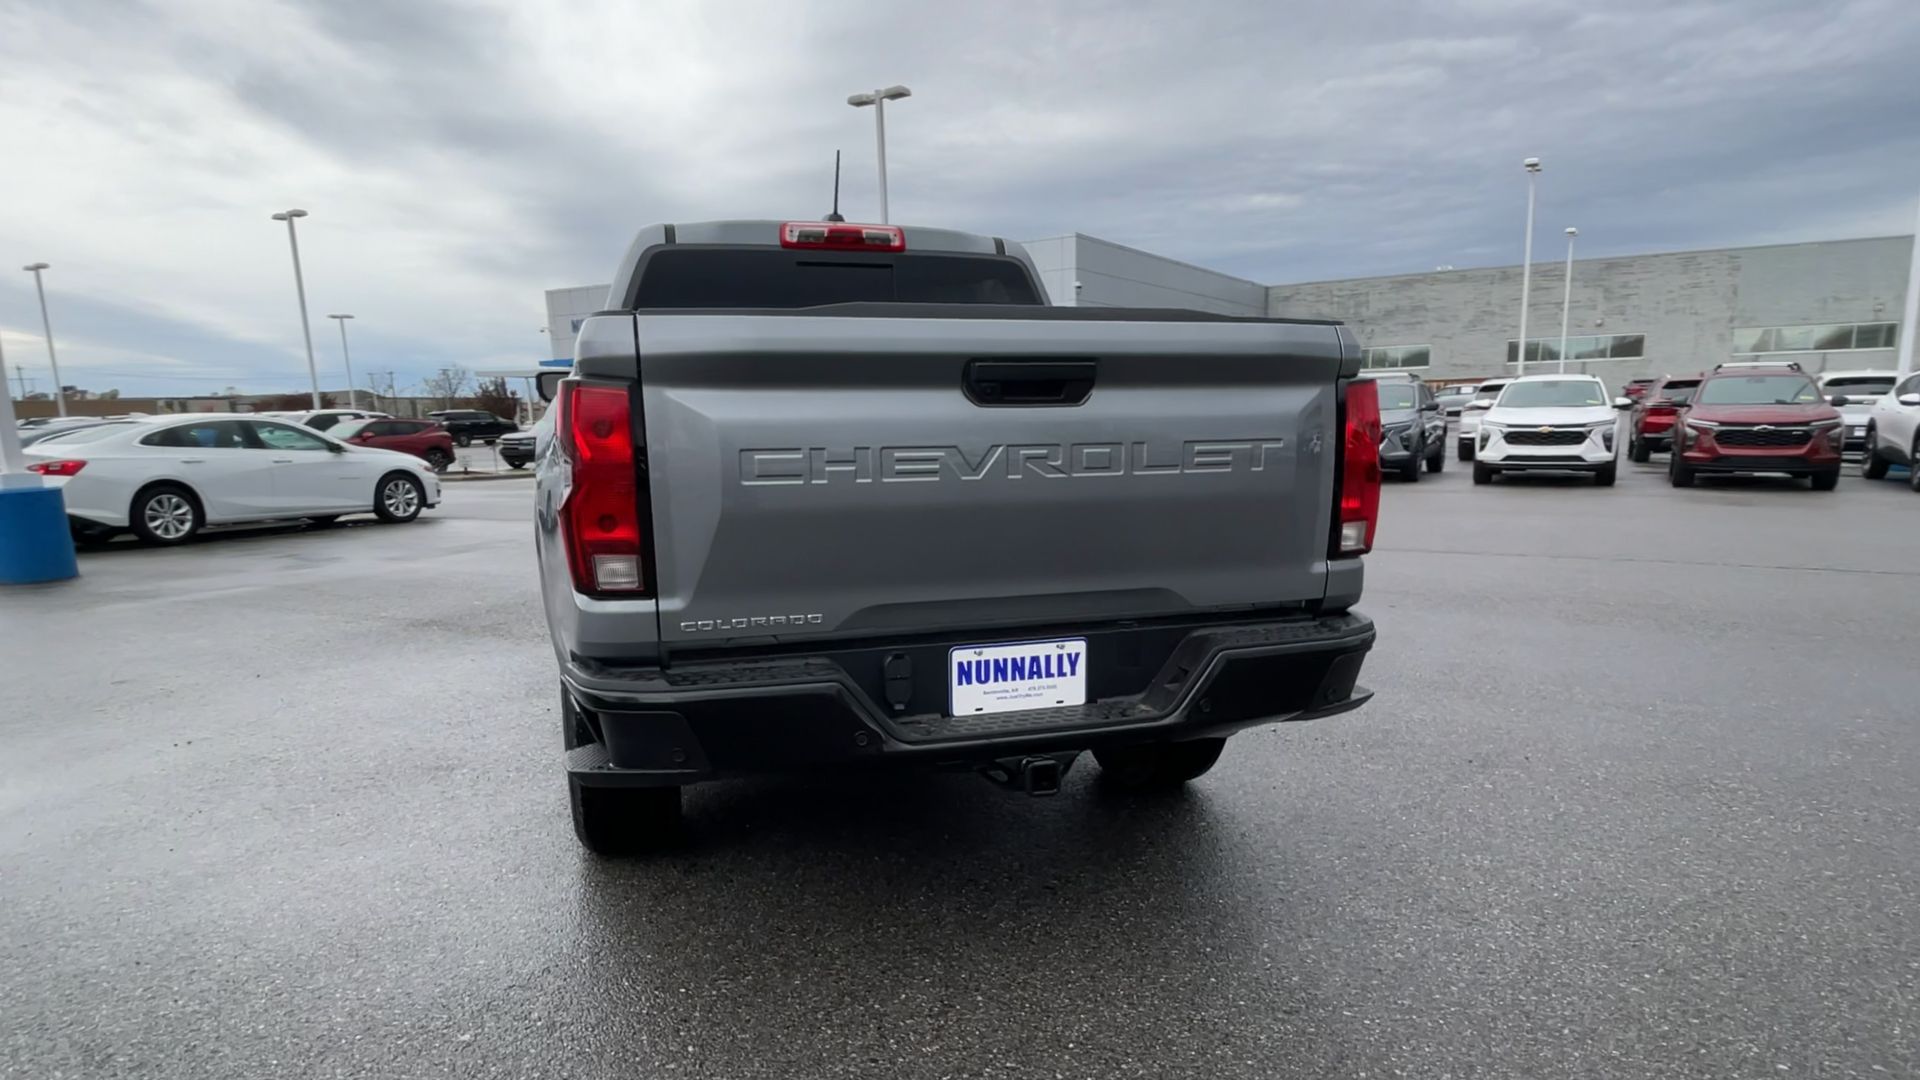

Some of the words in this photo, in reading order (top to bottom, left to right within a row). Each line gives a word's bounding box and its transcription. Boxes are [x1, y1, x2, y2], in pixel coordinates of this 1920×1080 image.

[739, 438, 1284, 486] CHEVROLET
[680, 613, 823, 632] COLORADO
[956, 652, 1081, 687] NUNNALLY
